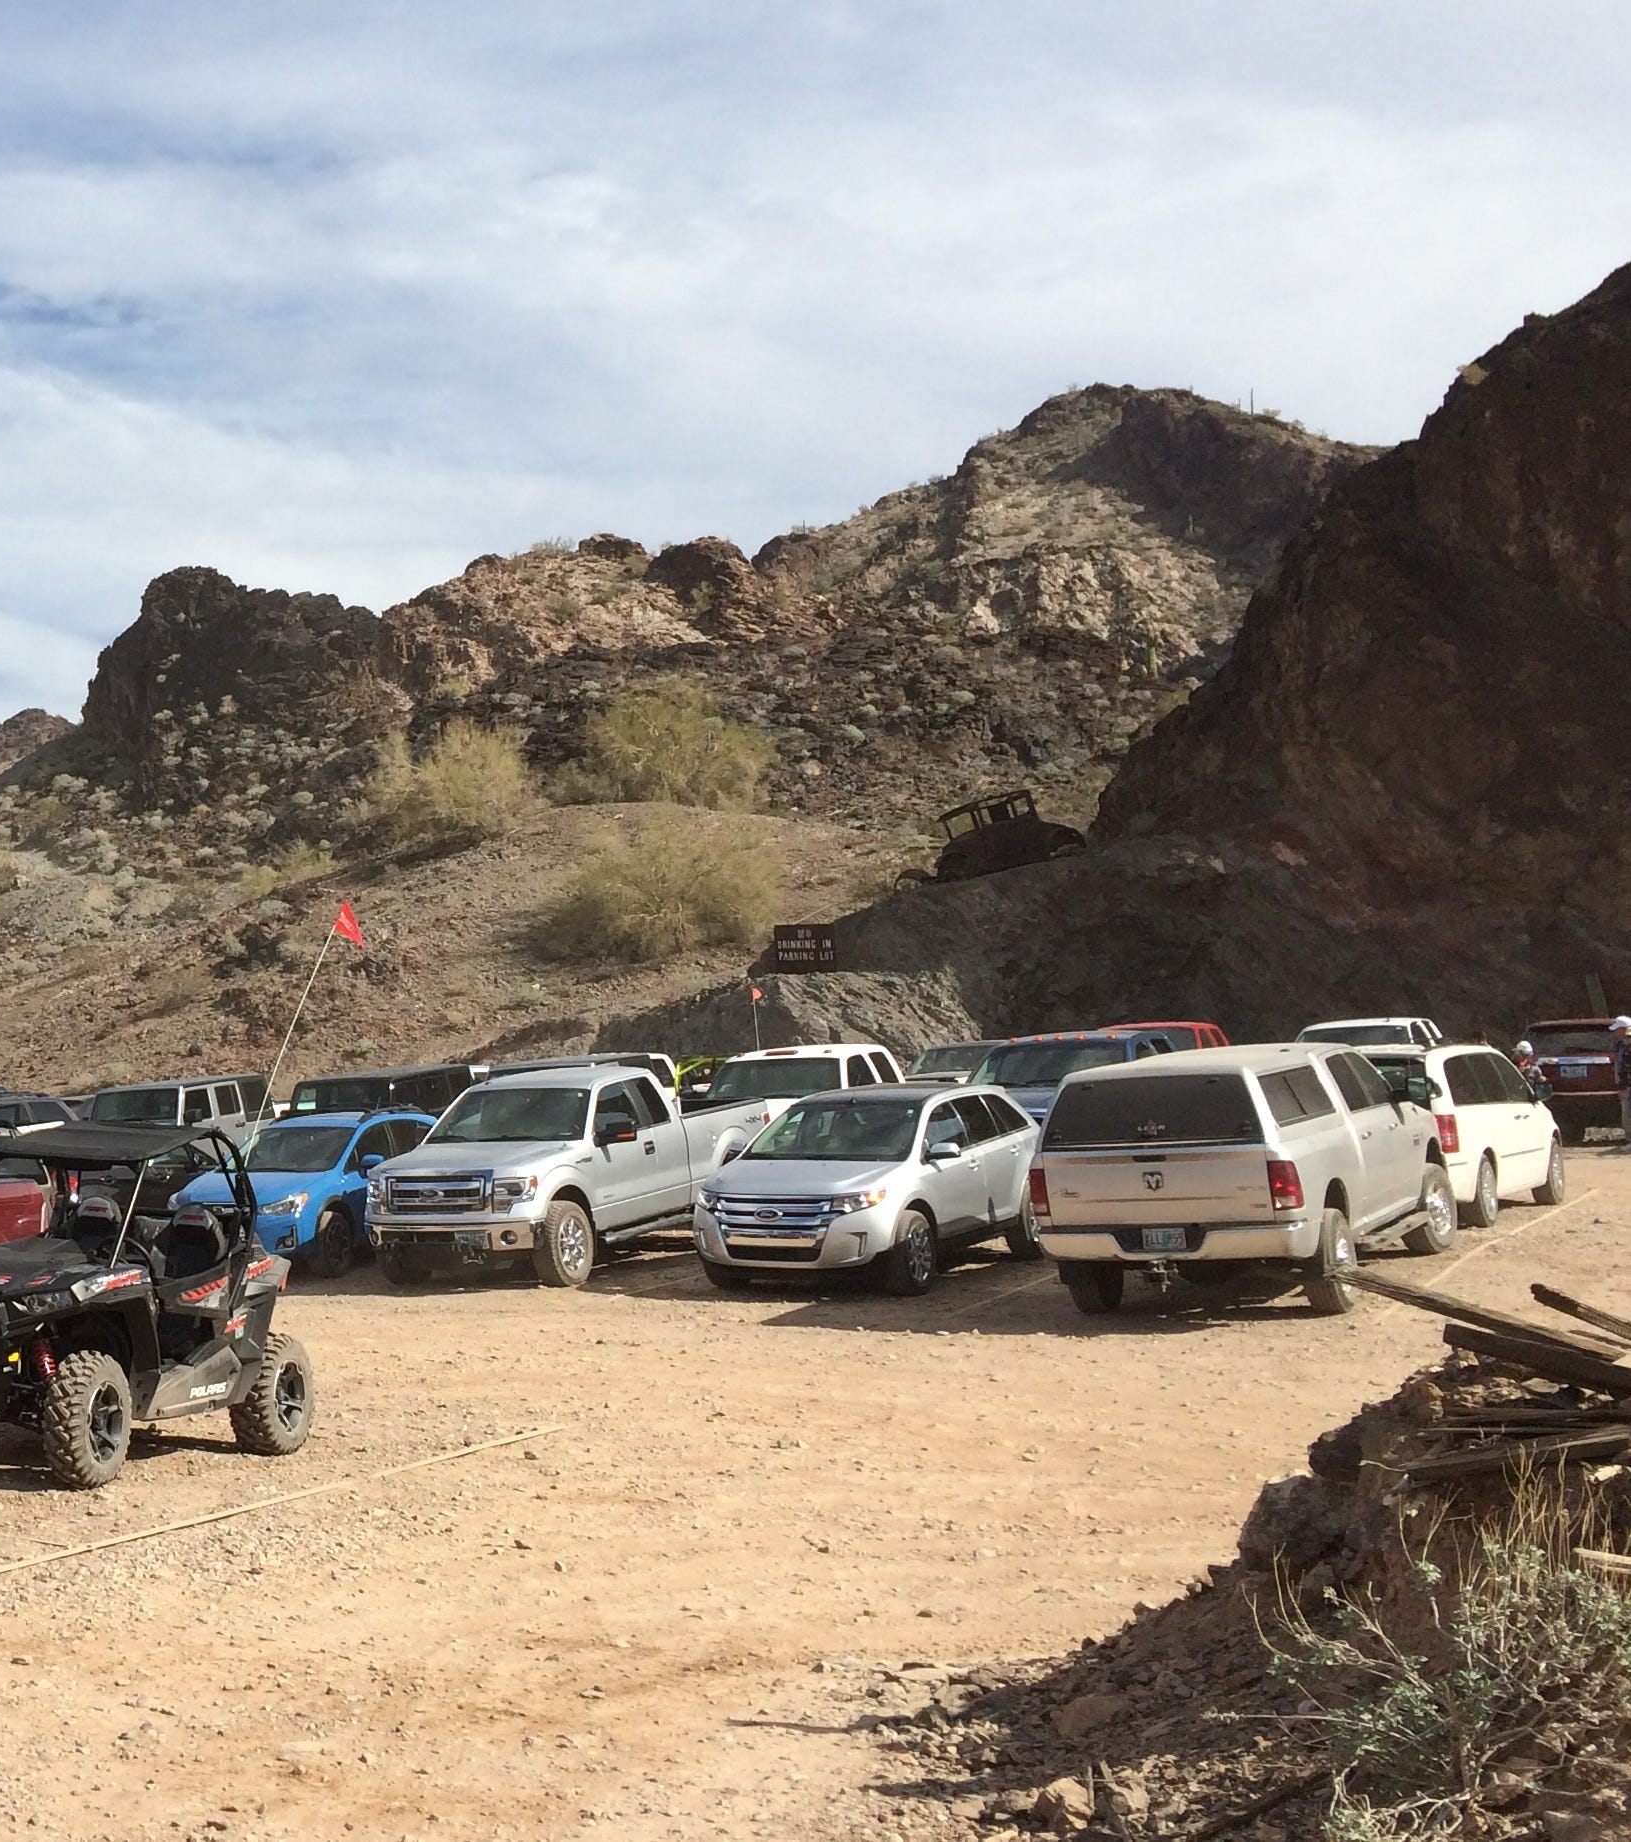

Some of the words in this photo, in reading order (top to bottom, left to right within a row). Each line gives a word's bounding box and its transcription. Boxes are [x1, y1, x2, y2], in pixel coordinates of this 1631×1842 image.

[777, 939, 817, 949] DRINKING
[822, 938, 832, 949] IN
[778, 951, 815, 961] PARKING
[819, 950, 834, 961] LOT
[190, 1381, 228, 1399] POLARIS
